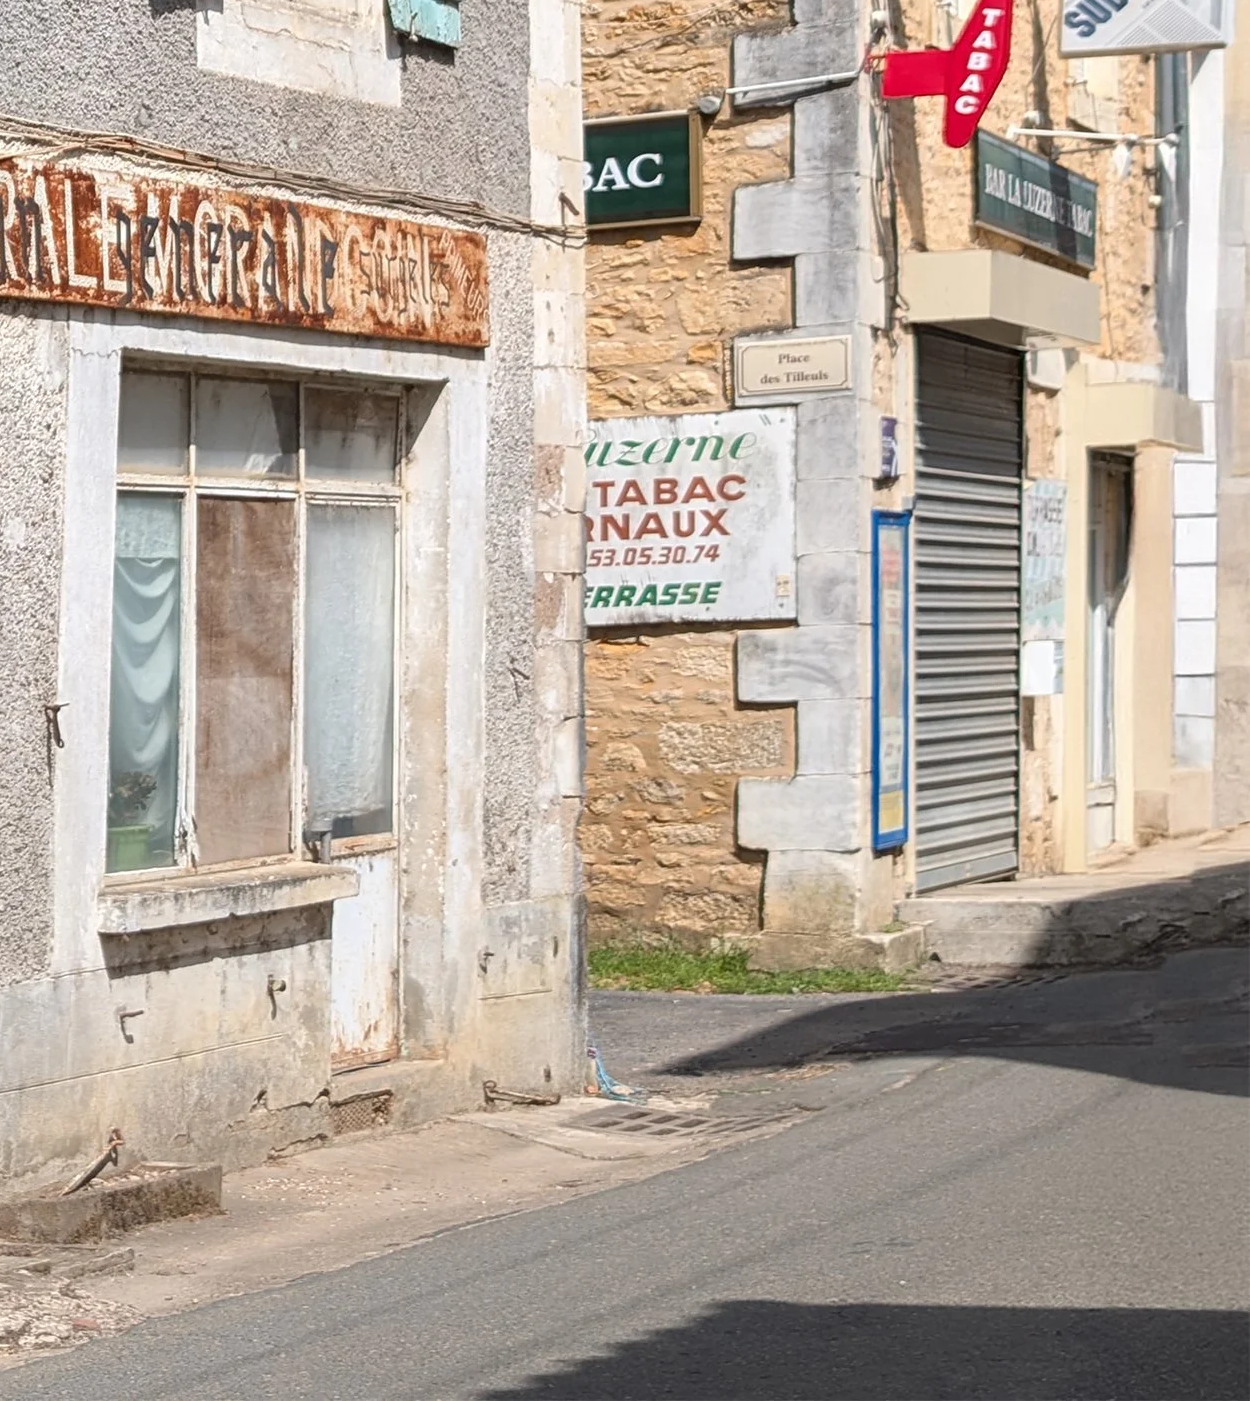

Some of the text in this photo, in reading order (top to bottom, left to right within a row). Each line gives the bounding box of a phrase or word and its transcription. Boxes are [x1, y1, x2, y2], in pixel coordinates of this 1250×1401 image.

[955, 7, 1006, 114] TABAC
[984, 163, 1007, 202] BAR
[1008, 173, 1022, 208] LA
[778, 353, 810, 365] Place
[760, 370, 829, 385] des Tilleuls
[592, 474, 747, 508] TABAC
